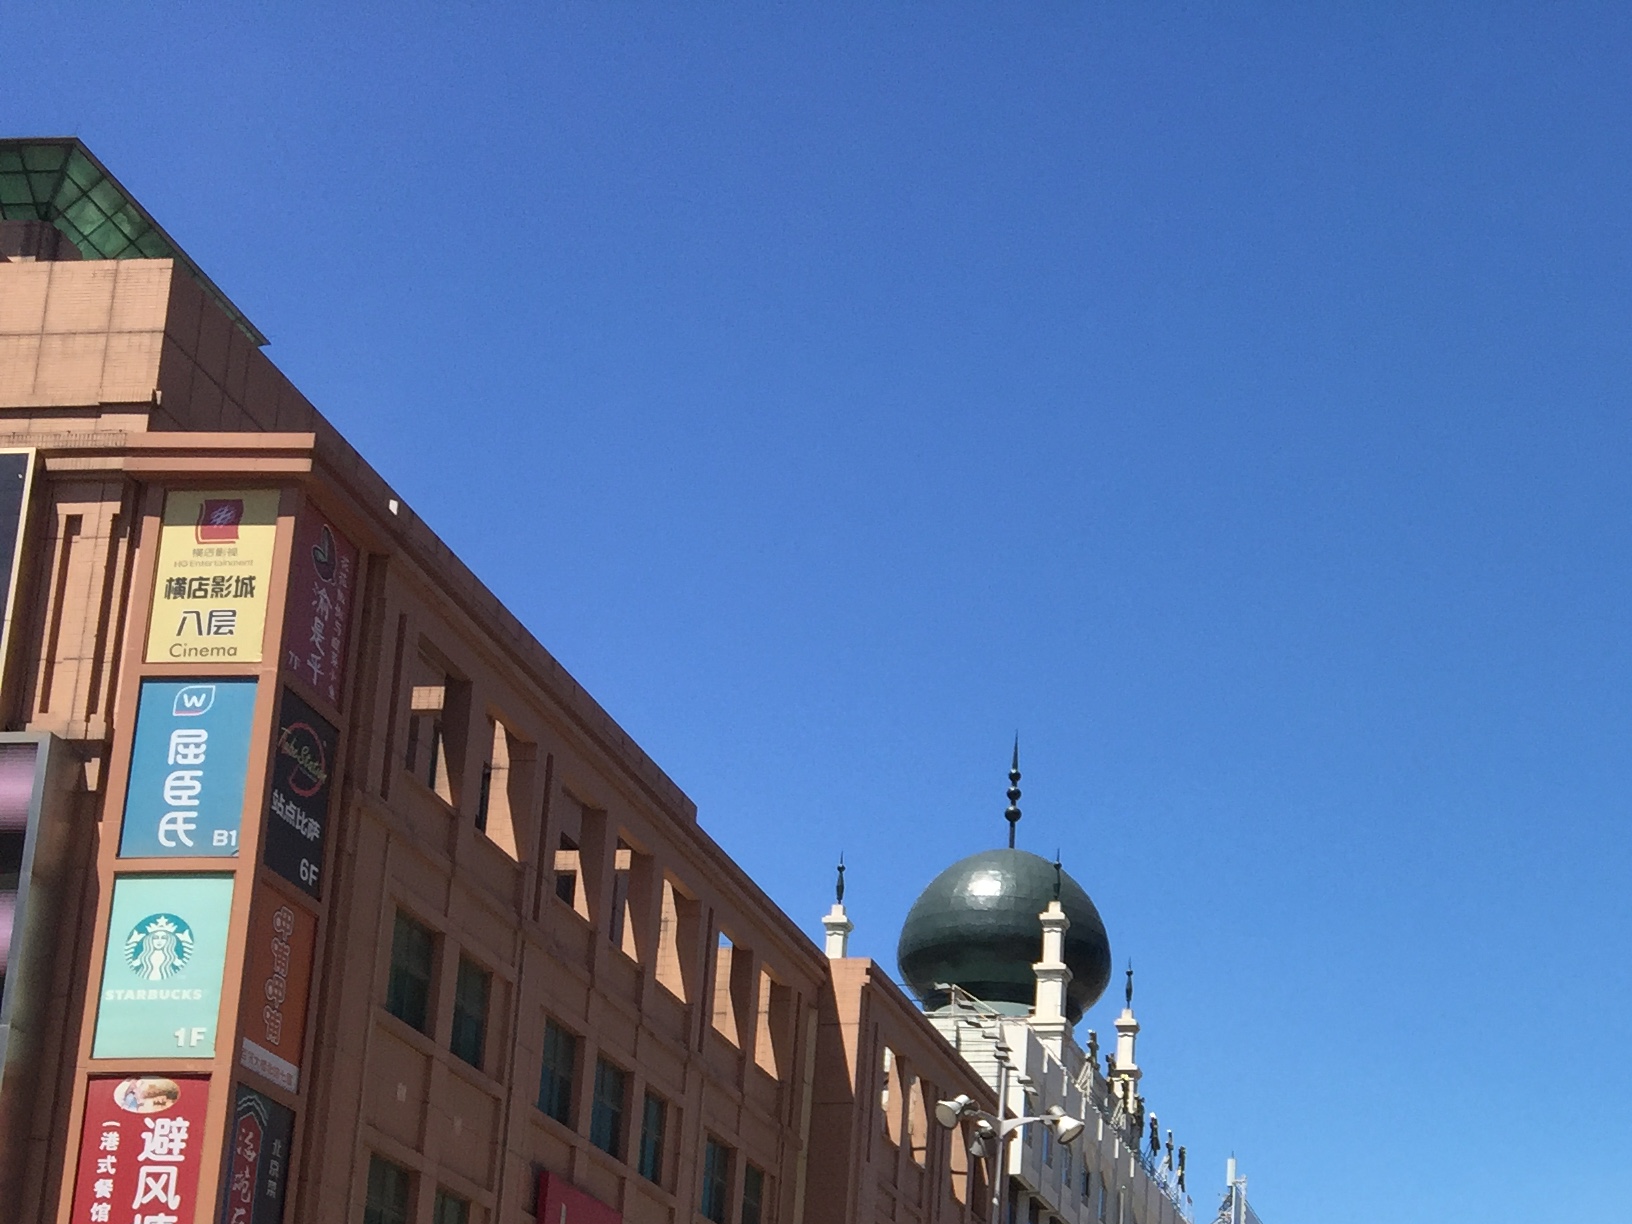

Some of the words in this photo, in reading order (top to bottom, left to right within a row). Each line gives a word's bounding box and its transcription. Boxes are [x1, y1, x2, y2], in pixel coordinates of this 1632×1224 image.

[189, 558, 253, 569] Entertainment
[164, 575, 256, 600] 横店影城
[176, 609, 237, 637] 八层
[169, 643, 238, 658] Cinema
[157, 728, 209, 847] 屈臣氏
[212, 829, 237, 847] B1
[299, 858, 319, 887] 6F
[105, 988, 202, 1001] STARBUCKS
[173, 1027, 206, 1048] 1F
